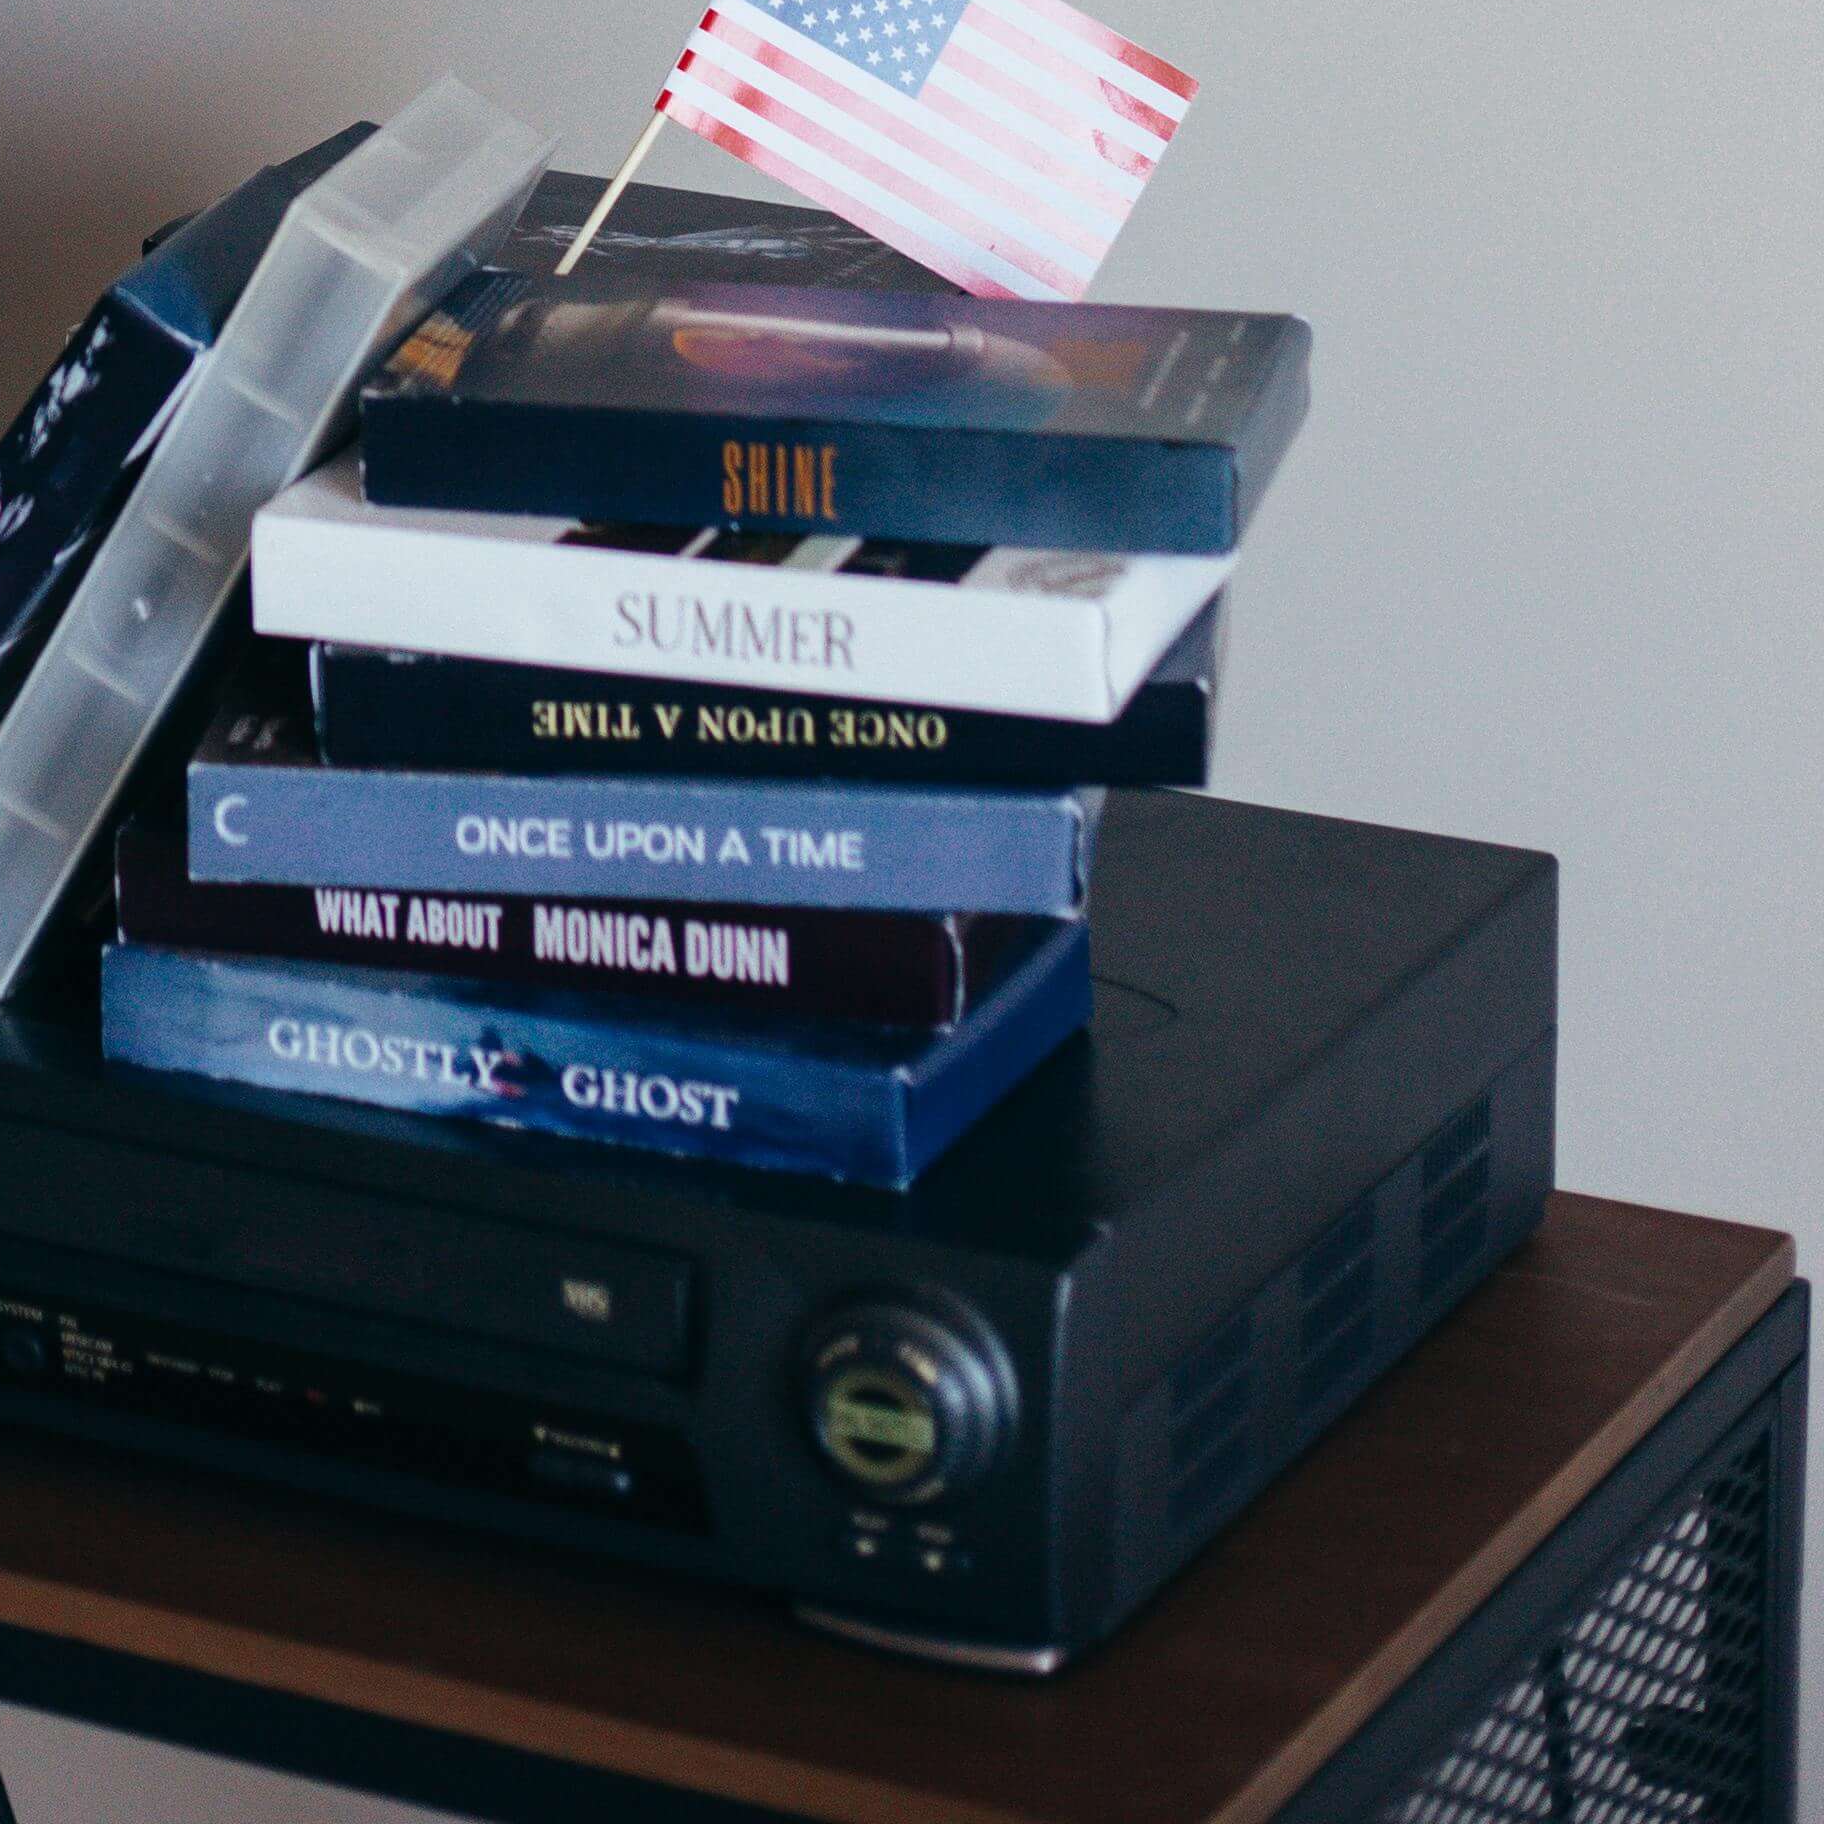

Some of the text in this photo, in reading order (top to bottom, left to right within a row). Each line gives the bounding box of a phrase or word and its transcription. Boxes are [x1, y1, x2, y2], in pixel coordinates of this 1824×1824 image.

[722, 439, 840, 521] SHINE
[612, 590, 856, 670] SUMMER
[531, 700, 947, 750] ONCE UPON A TIME
[455, 815, 864, 872] ONCE UPON A TIME
[315, 887, 789, 987] WHAT ABOUT MONICA DUNN
[267, 1019, 739, 1129] GHOSTLY GHOST
